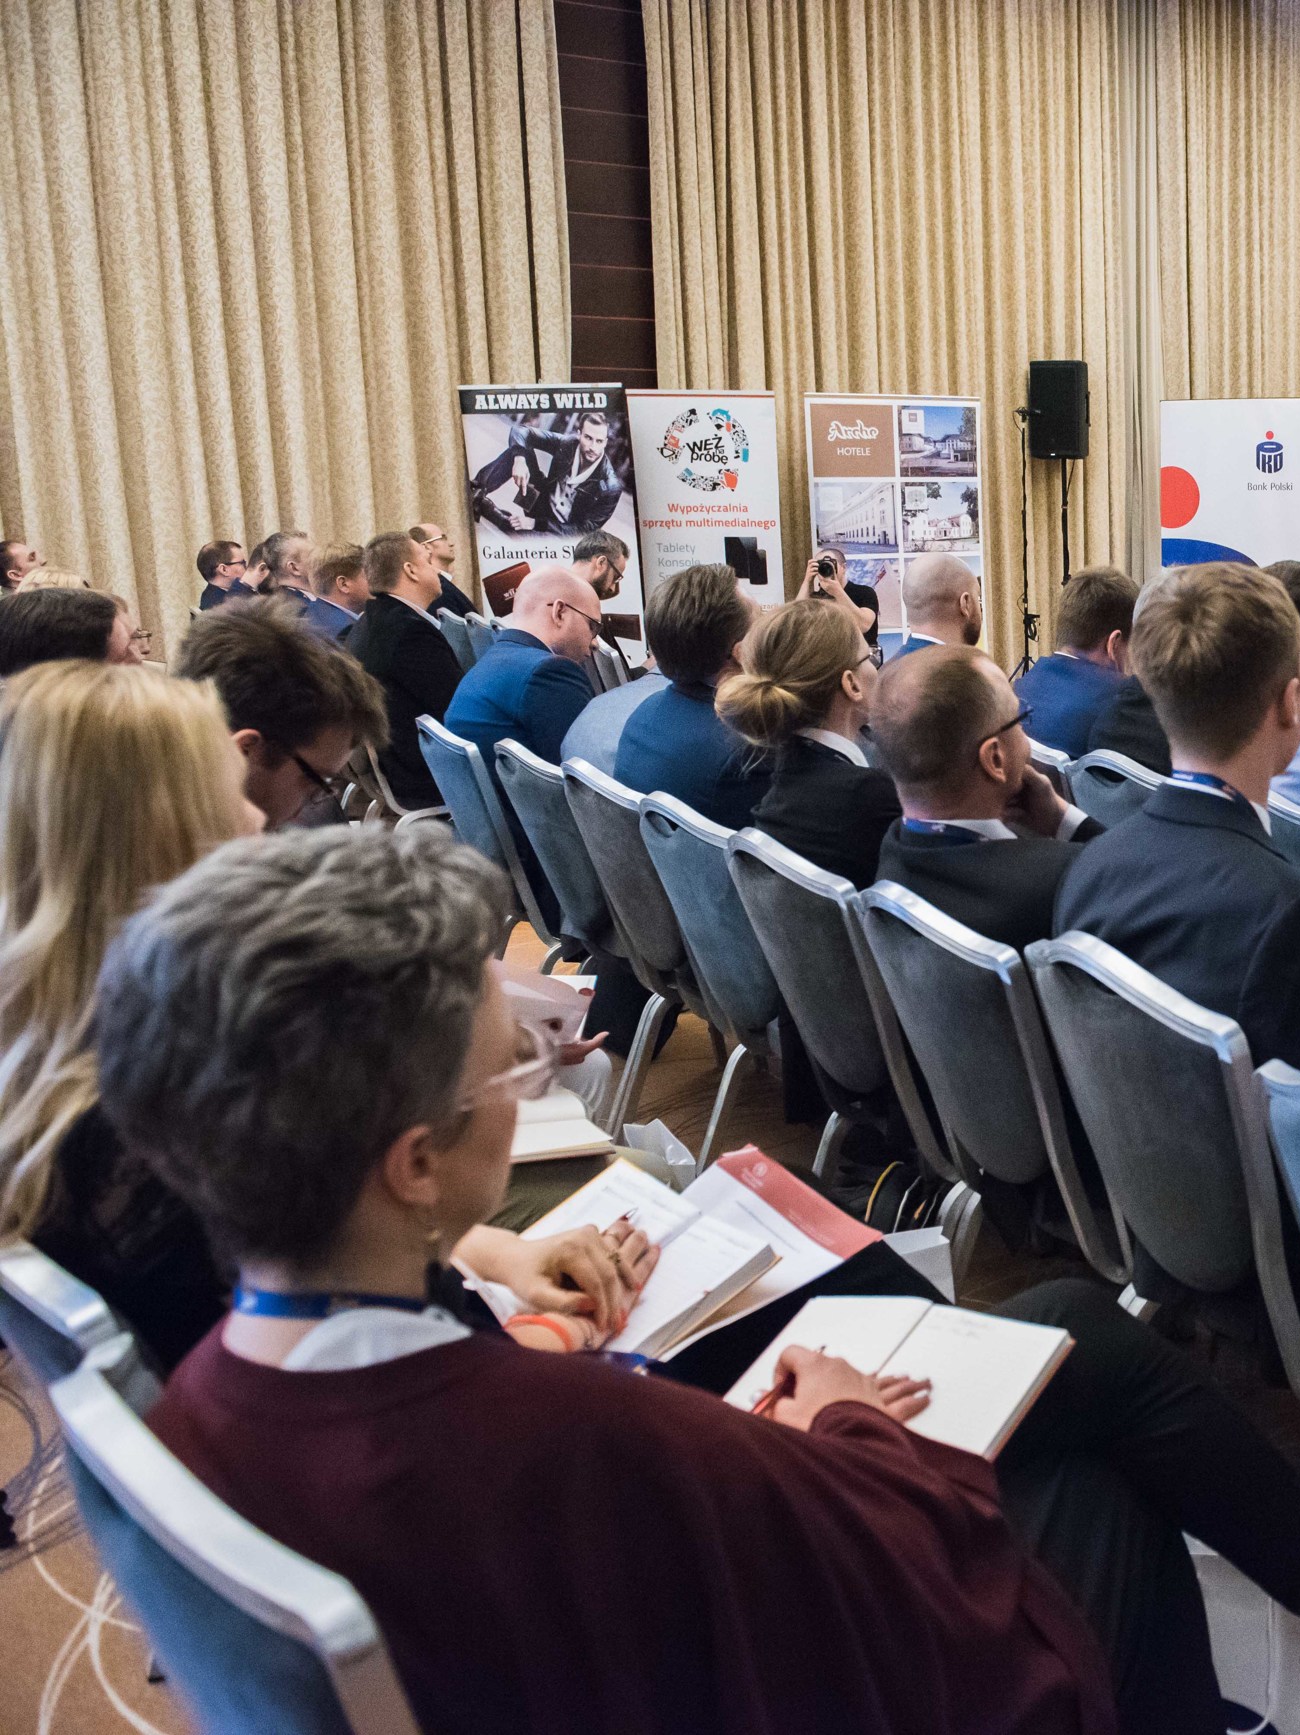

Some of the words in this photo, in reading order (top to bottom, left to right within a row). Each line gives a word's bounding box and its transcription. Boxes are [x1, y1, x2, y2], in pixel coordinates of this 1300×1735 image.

[475, 393, 550, 410] ALWAYS
[553, 392, 608, 409] WILD
[837, 447, 871, 456] HOTELE
[690, 450, 729, 466] próbę
[1247, 482, 1267, 491] Bank
[1270, 482, 1293, 491] Polski
[668, 503, 749, 515] Wypożyczalnia
[642, 519, 682, 530] sprzętu
[685, 518, 777, 530] multimedialnego
[482, 546, 558, 560] Galanteria
[656, 543, 696, 555] Tablety
